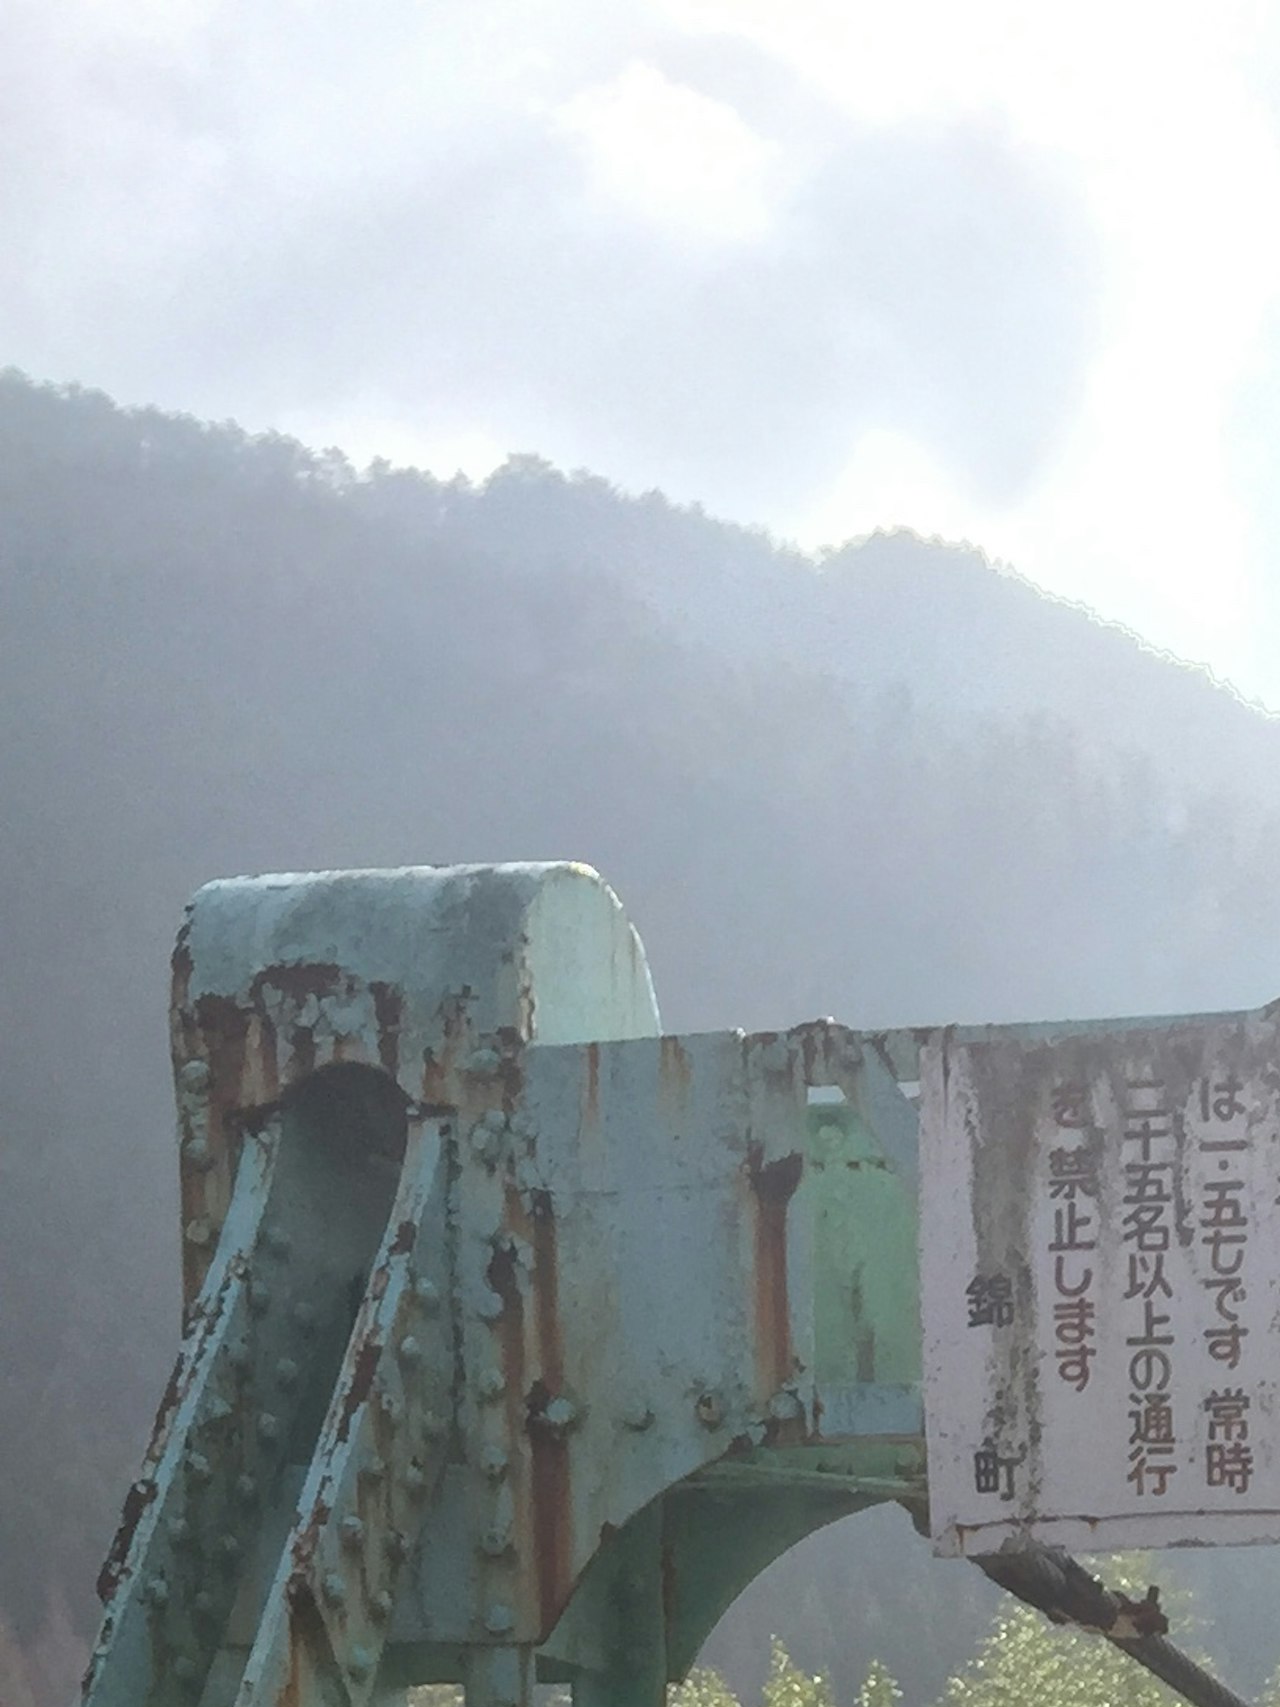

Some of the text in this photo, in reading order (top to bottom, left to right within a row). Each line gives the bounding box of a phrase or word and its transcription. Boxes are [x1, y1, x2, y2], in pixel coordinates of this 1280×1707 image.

[1048, 1080, 1099, 1393] を禁止します
[1123, 1081, 1177, 1496] 二十五名以上の通行
